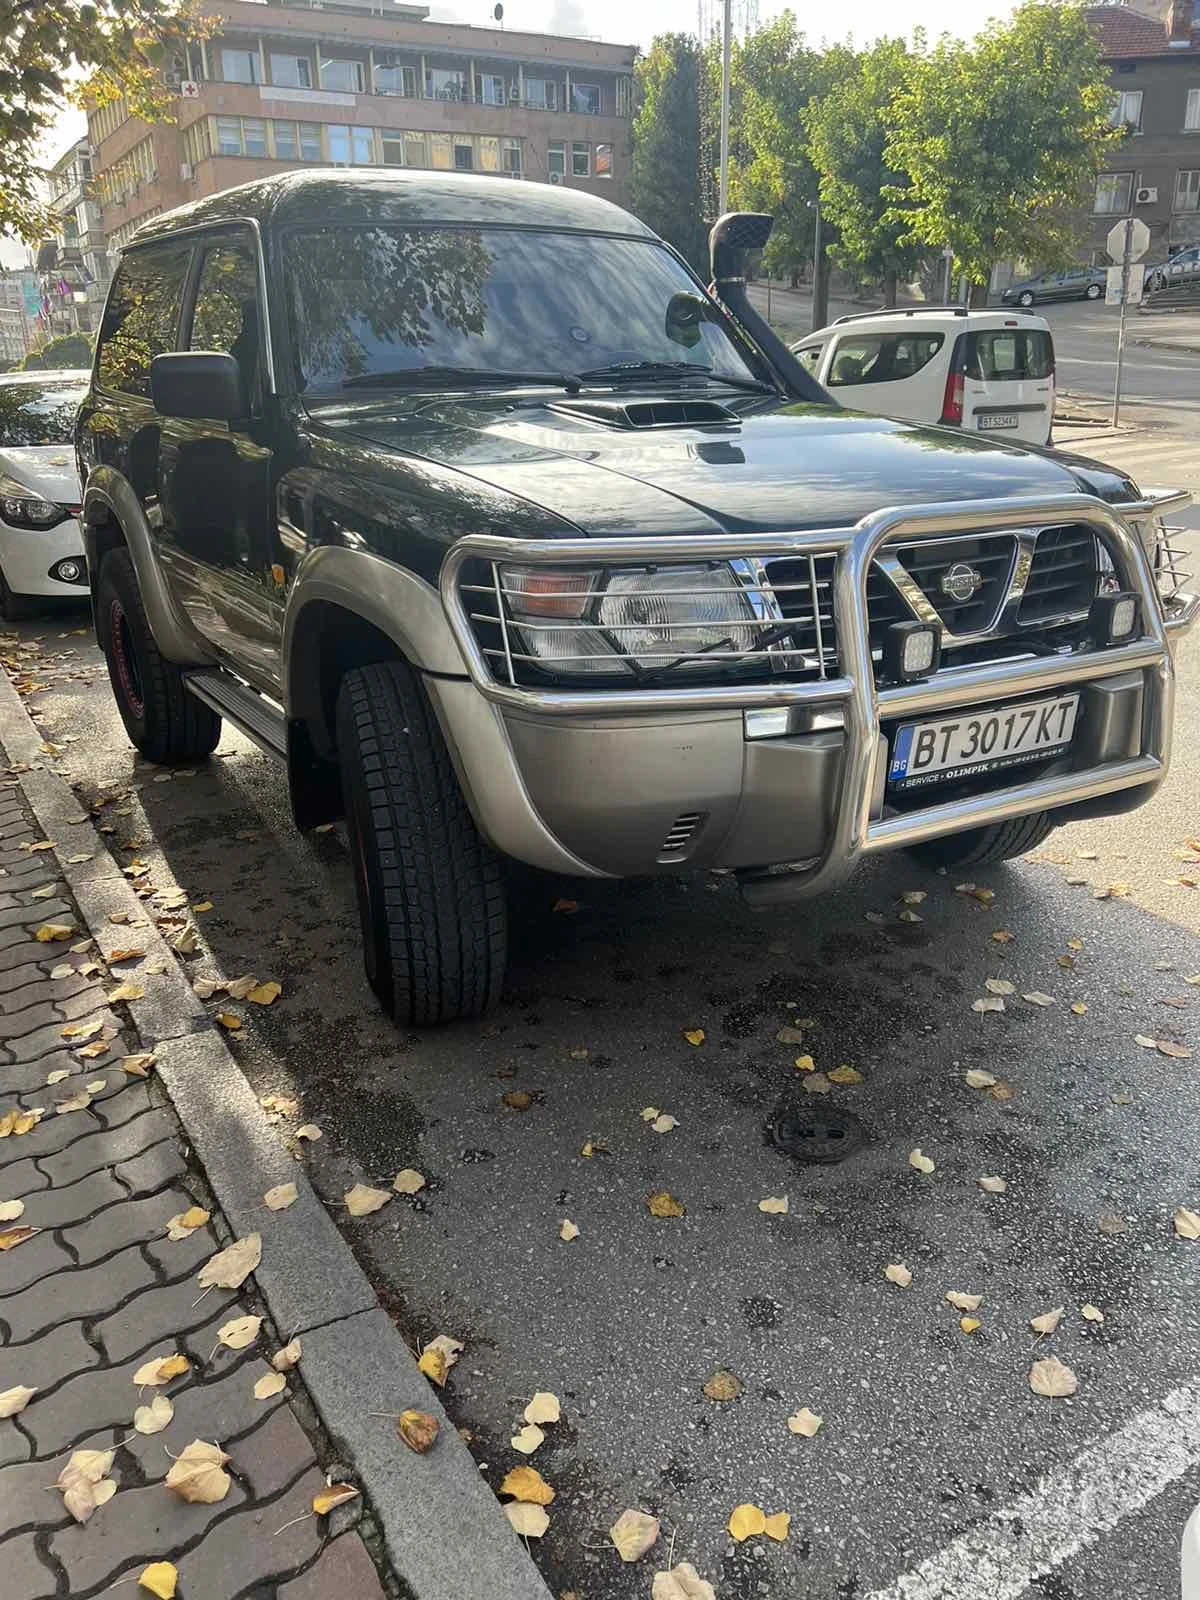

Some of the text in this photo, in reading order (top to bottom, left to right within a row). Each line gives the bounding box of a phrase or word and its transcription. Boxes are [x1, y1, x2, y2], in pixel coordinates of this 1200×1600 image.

[892, 759, 907, 772] BG
[906, 763, 989, 788] SERVICE OLIMPIK
